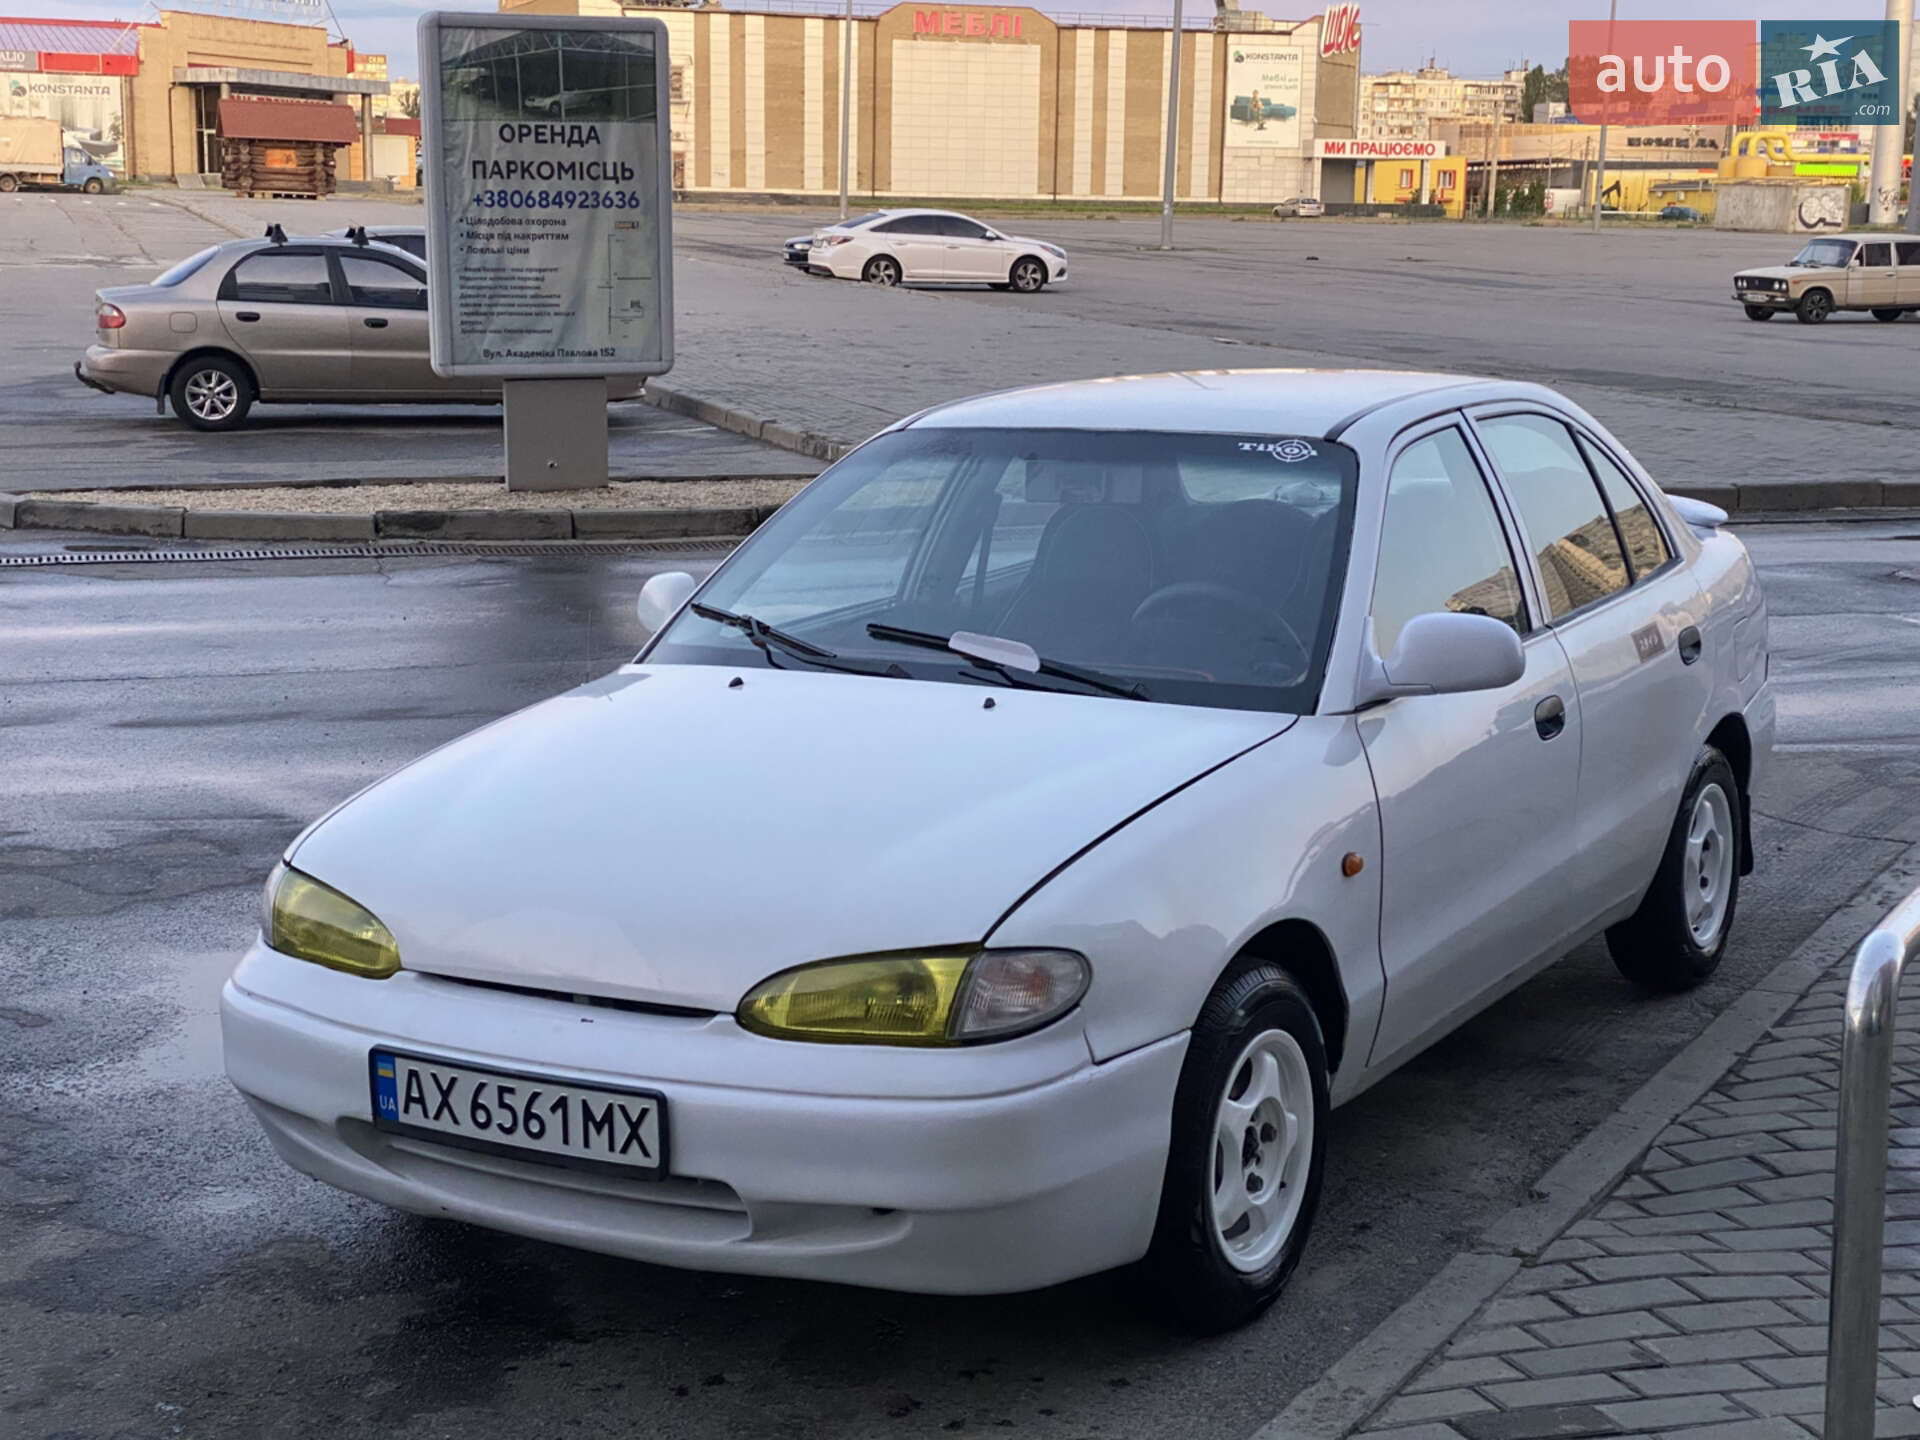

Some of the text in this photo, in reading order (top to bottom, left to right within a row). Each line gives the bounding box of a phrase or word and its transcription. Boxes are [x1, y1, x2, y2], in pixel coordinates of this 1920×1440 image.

[913, 10, 1023, 38] МЕБЛІ
[1246, 53, 1298, 61] KONSTANTA
[28, 83, 111, 95] KONSTANTA
[499, 124, 601, 148] ОРЕНДА
[1324, 141, 1436, 157] МИ ПРАЦЮЄМО
[472, 160, 635, 184] ПАРКОМІСЦЬ
[472, 189, 640, 209] +380684923636
[525, 217, 567, 228] охорона
[497, 231, 512, 241] під
[507, 246, 530, 256] ціни
[600, 347, 616, 358] 152
[379, 1094, 397, 1112] UA
[402, 1067, 652, 1159] AX 6561 MX
